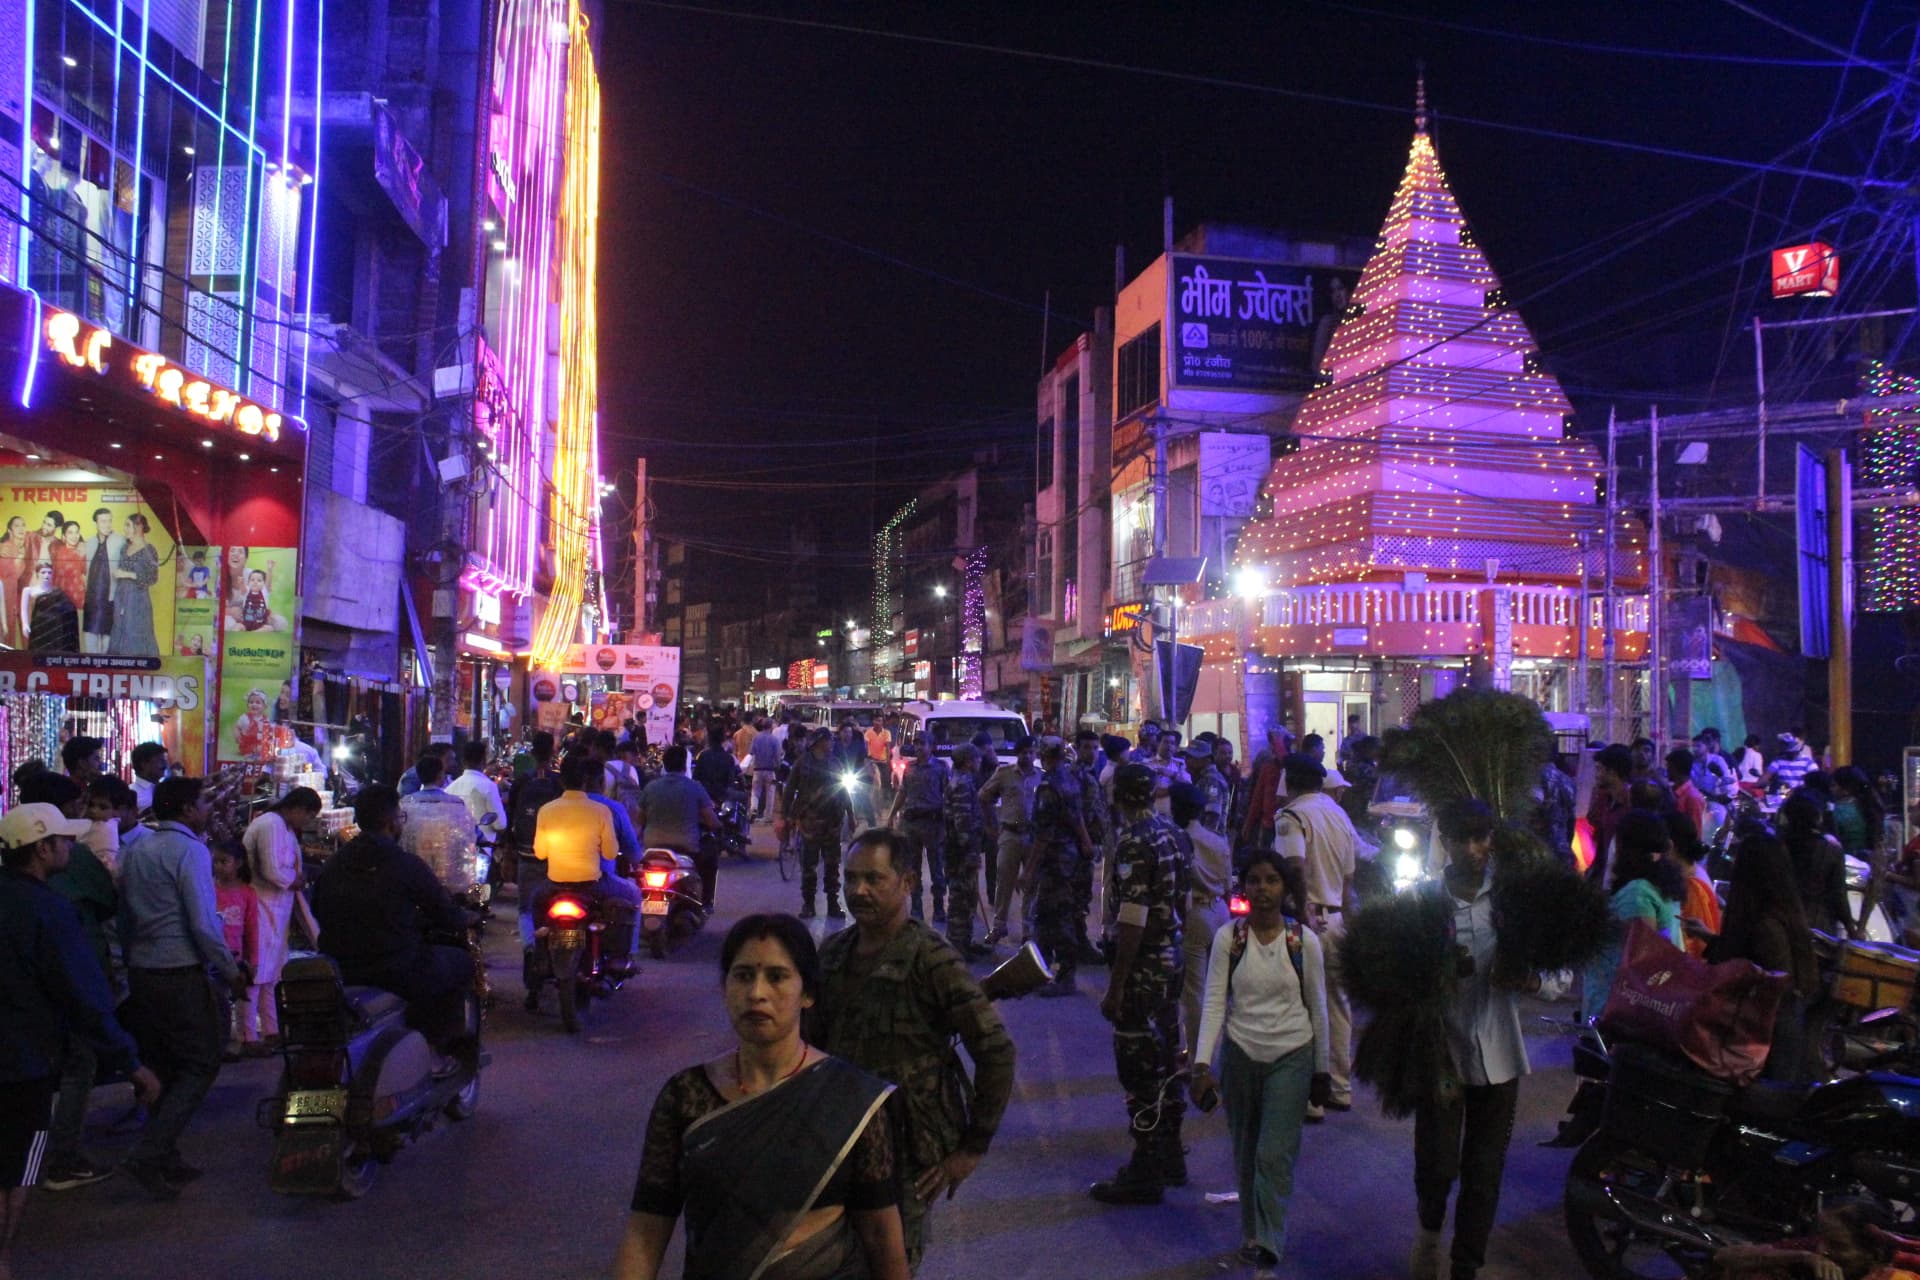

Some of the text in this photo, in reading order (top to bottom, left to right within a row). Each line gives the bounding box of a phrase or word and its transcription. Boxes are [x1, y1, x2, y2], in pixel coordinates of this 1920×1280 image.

[1783, 250, 1808, 276] V
[1181, 264, 1232, 319] भीम
[1777, 273, 1813, 289] MART
[136, 354, 281, 442] TRENDS
[11, 487, 88, 505] TRENDS
[67, 672, 199, 711] TRENDS
